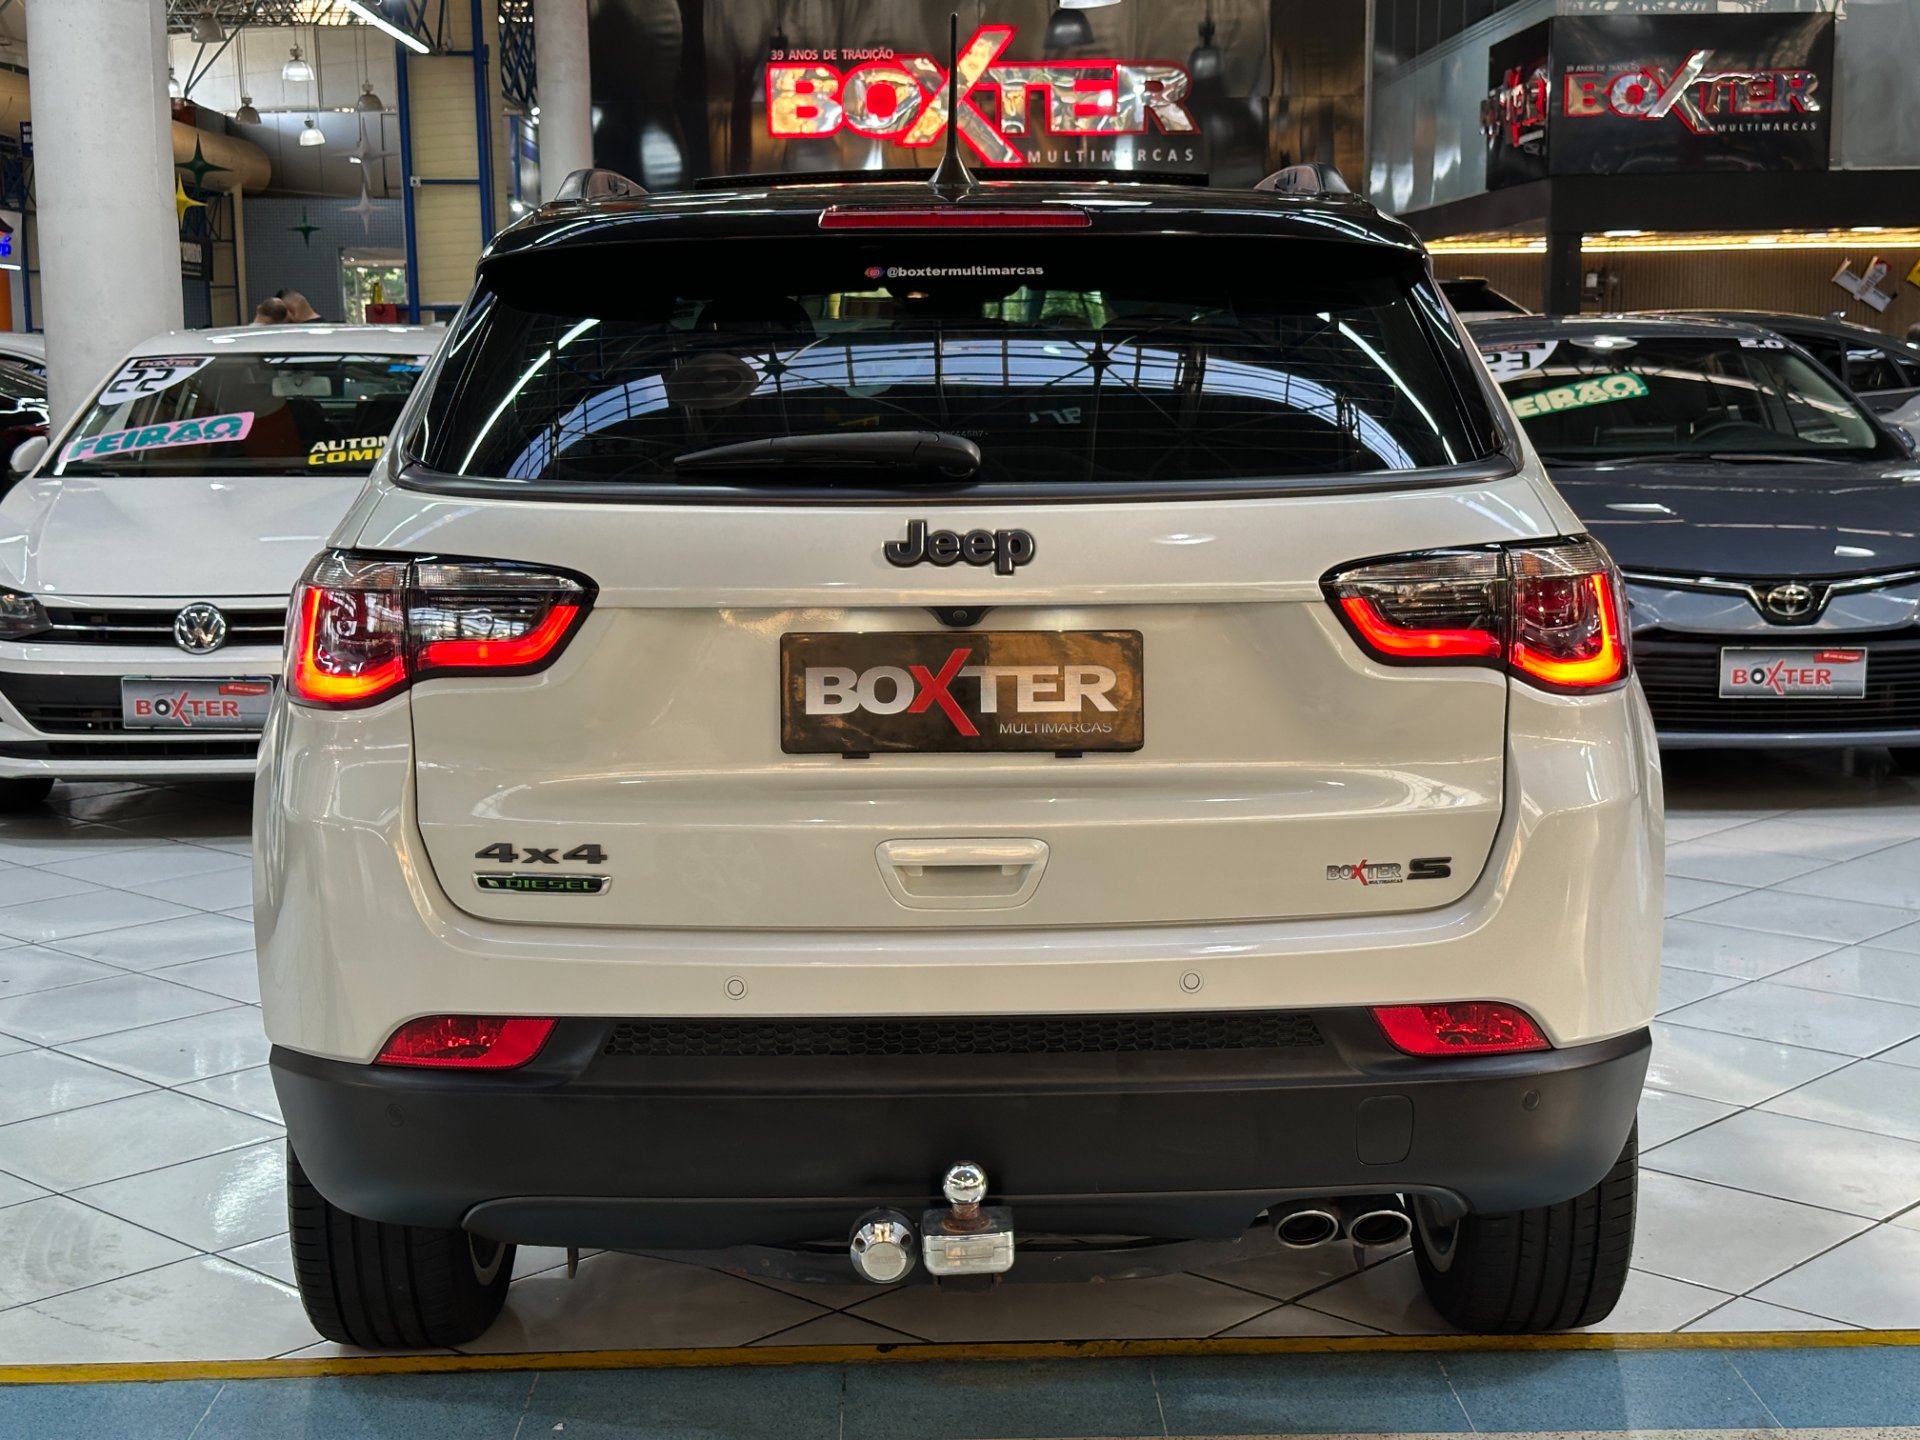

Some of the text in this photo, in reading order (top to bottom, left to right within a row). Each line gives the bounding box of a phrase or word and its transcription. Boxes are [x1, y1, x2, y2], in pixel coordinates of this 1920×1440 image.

[771, 46, 894, 61] 39 ANOS DE TRADIÇÃO
[766, 24, 1200, 167] BOXTER
[1563, 49, 1821, 134] BOXTER
[1717, 121, 1818, 133] MULTIMARCAS
[1027, 148, 1194, 164] MULTIMRCAS
[887, 265, 1044, 278] @boxtermultimarcas
[139, 359, 197, 368] BOXTER
[107, 368, 176, 394] 22
[1510, 375, 1642, 417] EIRÃO
[67, 415, 244, 460] FEIRÃO
[881, 519, 1036, 577] Jeep
[1731, 658, 1832, 696] BOXTER
[804, 648, 1119, 737] BOXTER
[135, 690, 241, 726] BOXTER
[1000, 722, 1113, 734] MULTIMARCAS
[475, 842, 608, 864] 4x4
[505, 879, 597, 890] DIESEL
[1326, 856, 1452, 886] BOXTER S
